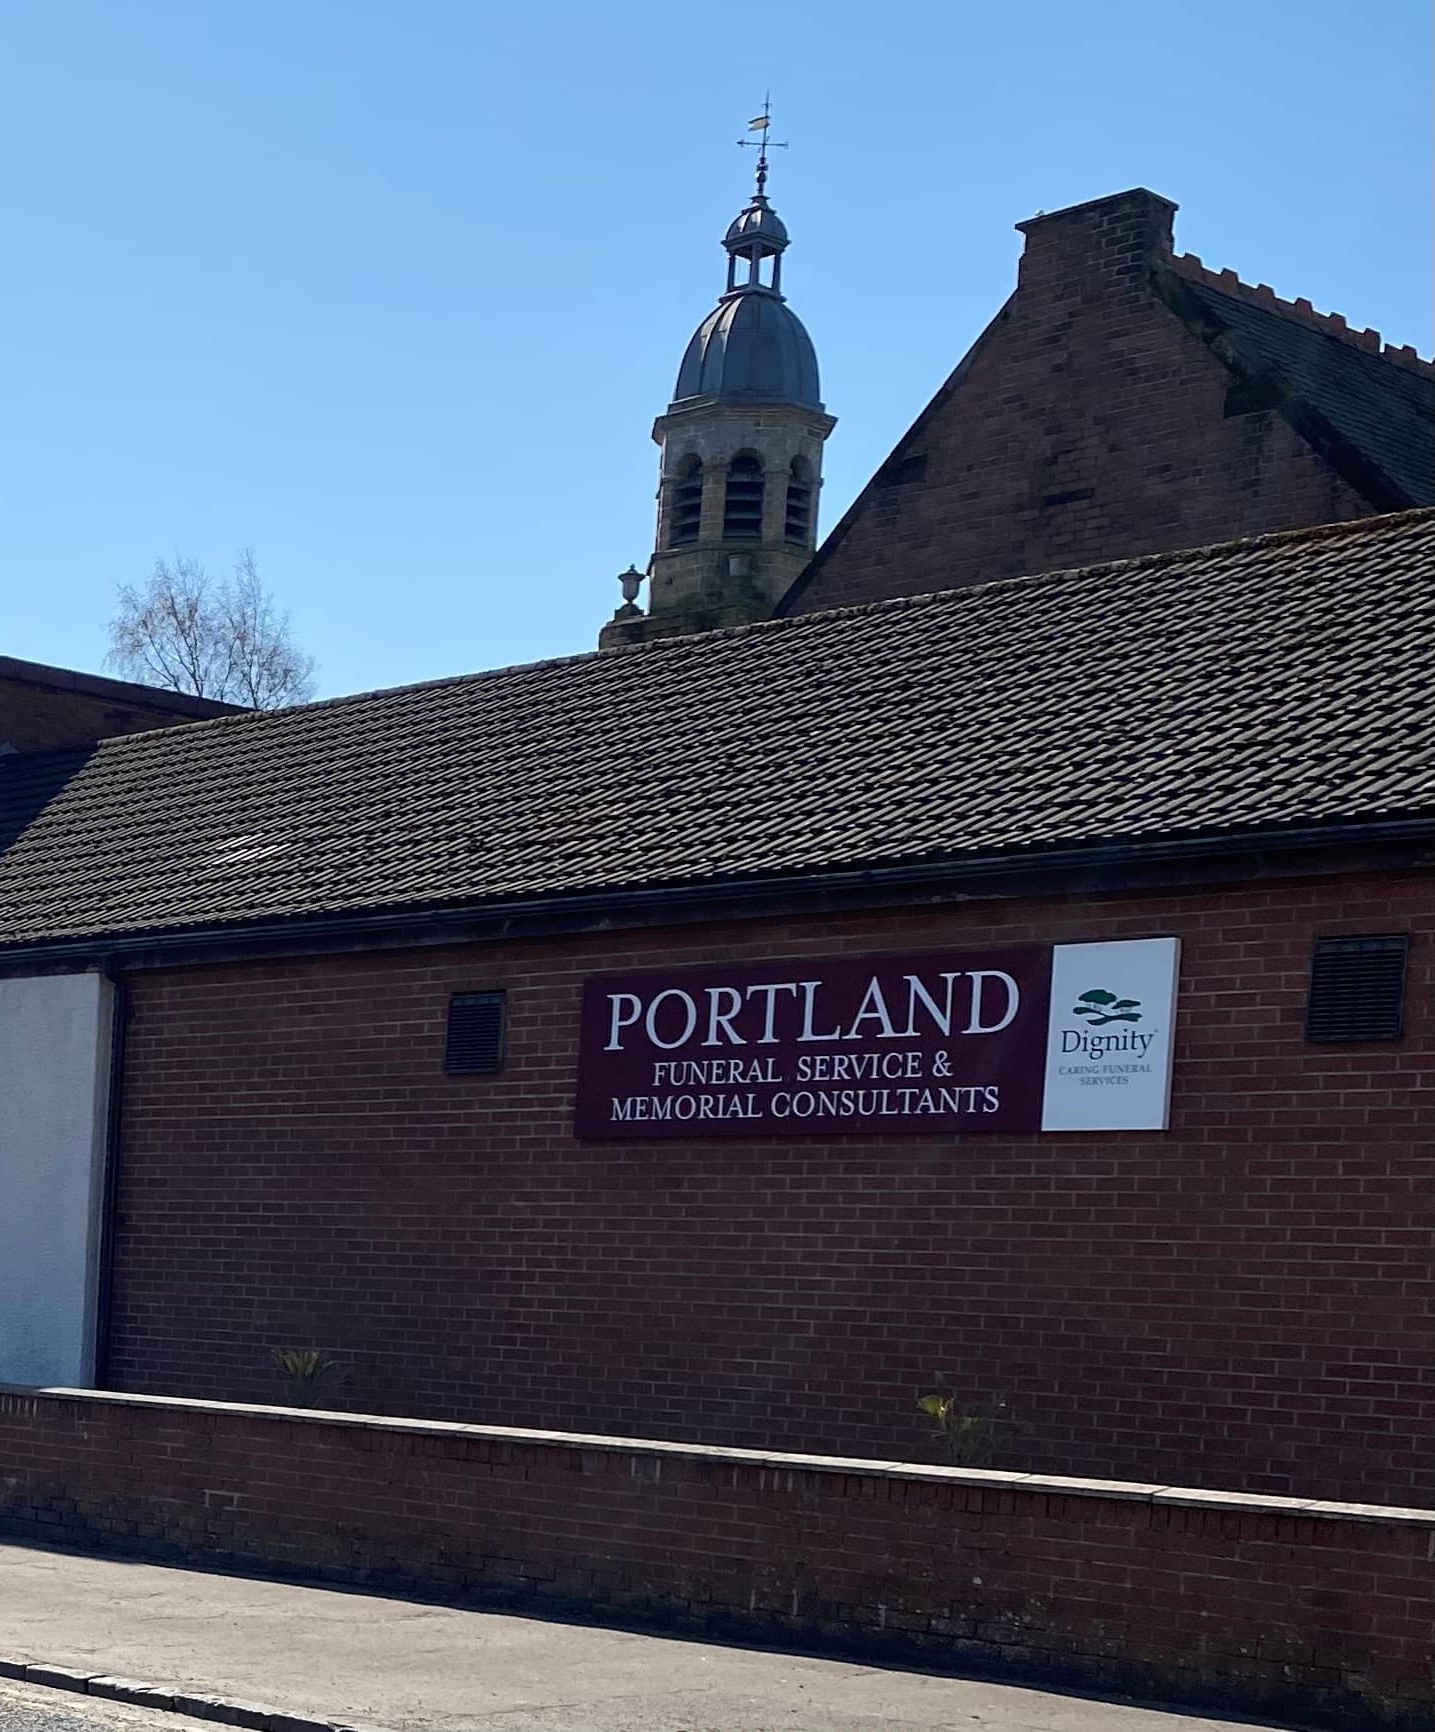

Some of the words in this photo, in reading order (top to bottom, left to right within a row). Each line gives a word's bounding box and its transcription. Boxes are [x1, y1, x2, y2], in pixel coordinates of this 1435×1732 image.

[603, 969, 1020, 1051] PORTLAND
[1061, 1028, 1154, 1060] Dignity
[652, 1058, 783, 1086] FUNERAL
[796, 1052, 923, 1082] SERVICE
[932, 1050, 953, 1077] &
[1079, 1076, 1129, 1086] SERVICES
[1104, 1064, 1152, 1074] FUNERAL
[610, 1093, 763, 1121] MEMORIAL
[770, 1086, 1000, 1117] CONSULTANTS
